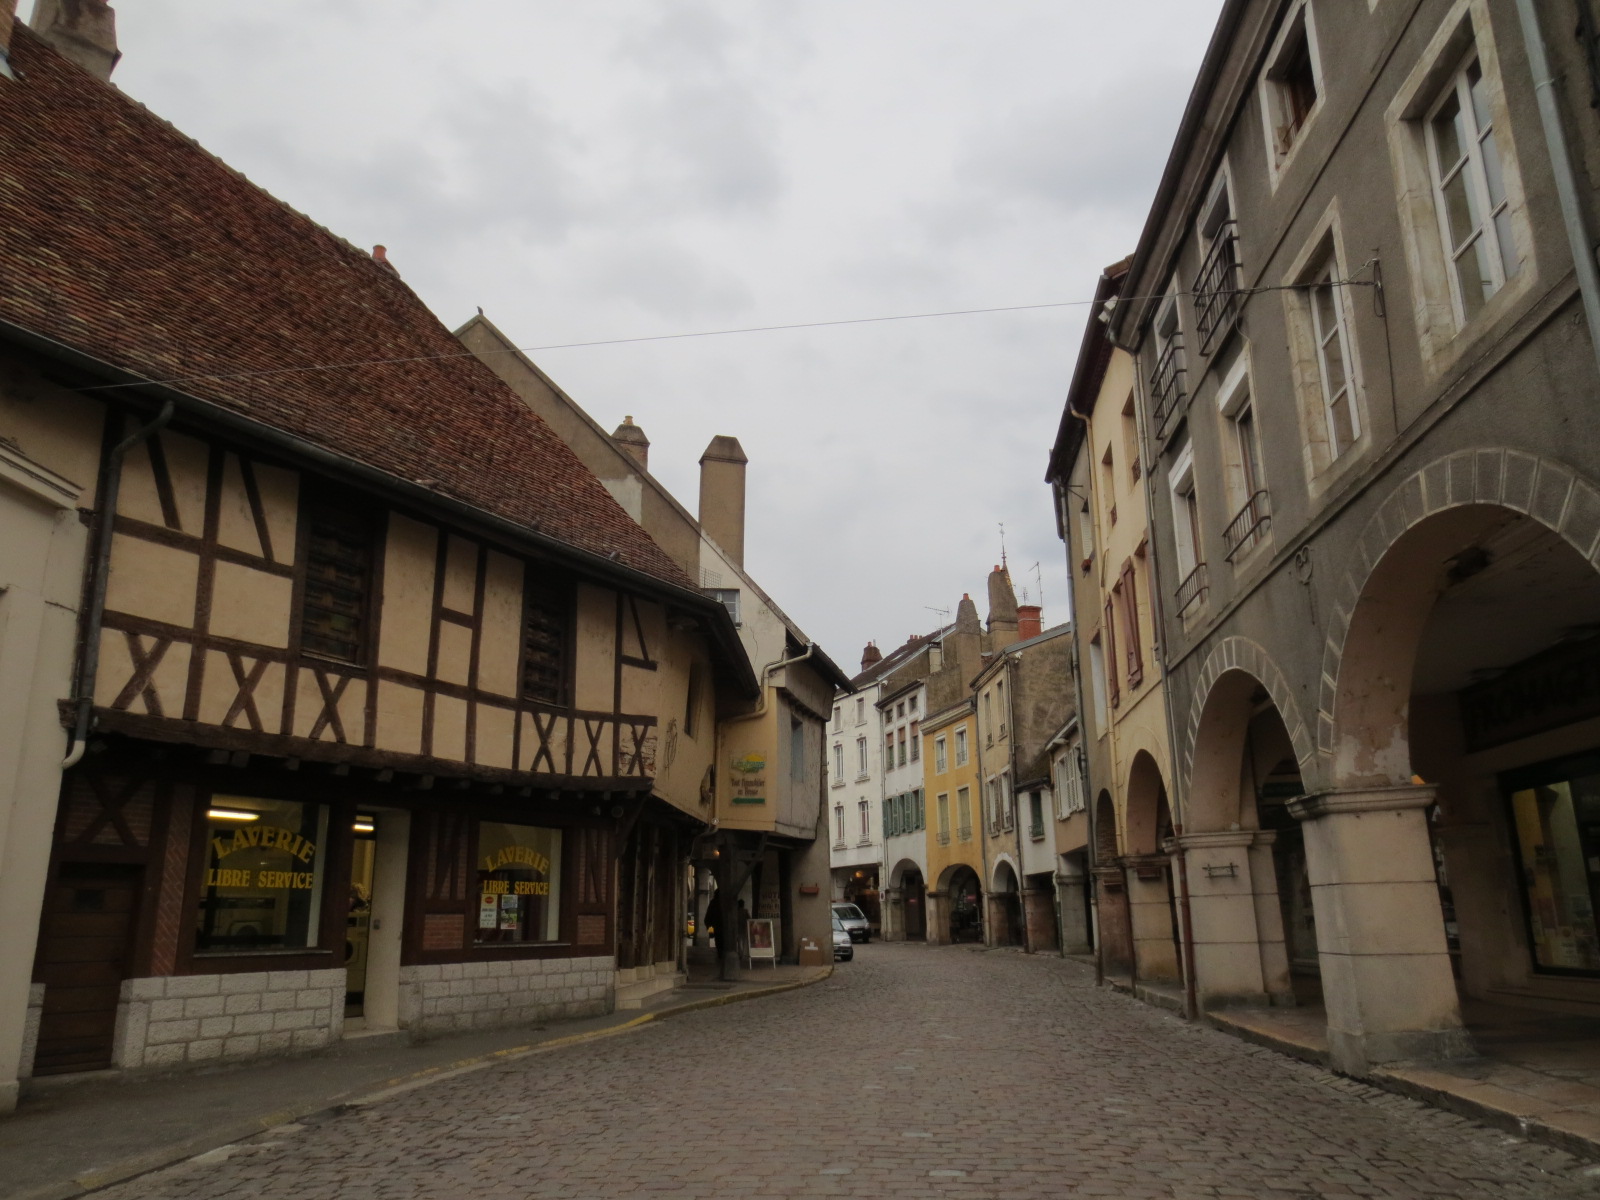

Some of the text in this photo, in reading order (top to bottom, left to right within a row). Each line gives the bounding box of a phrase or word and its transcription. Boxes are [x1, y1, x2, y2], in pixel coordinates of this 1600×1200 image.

[212, 826, 315, 863] LAVERIE
[485, 846, 549, 875] LAVERIE
[207, 868, 313, 889] LIBRE SERVICE
[483, 880, 549, 895] LIBRE SERVICE
